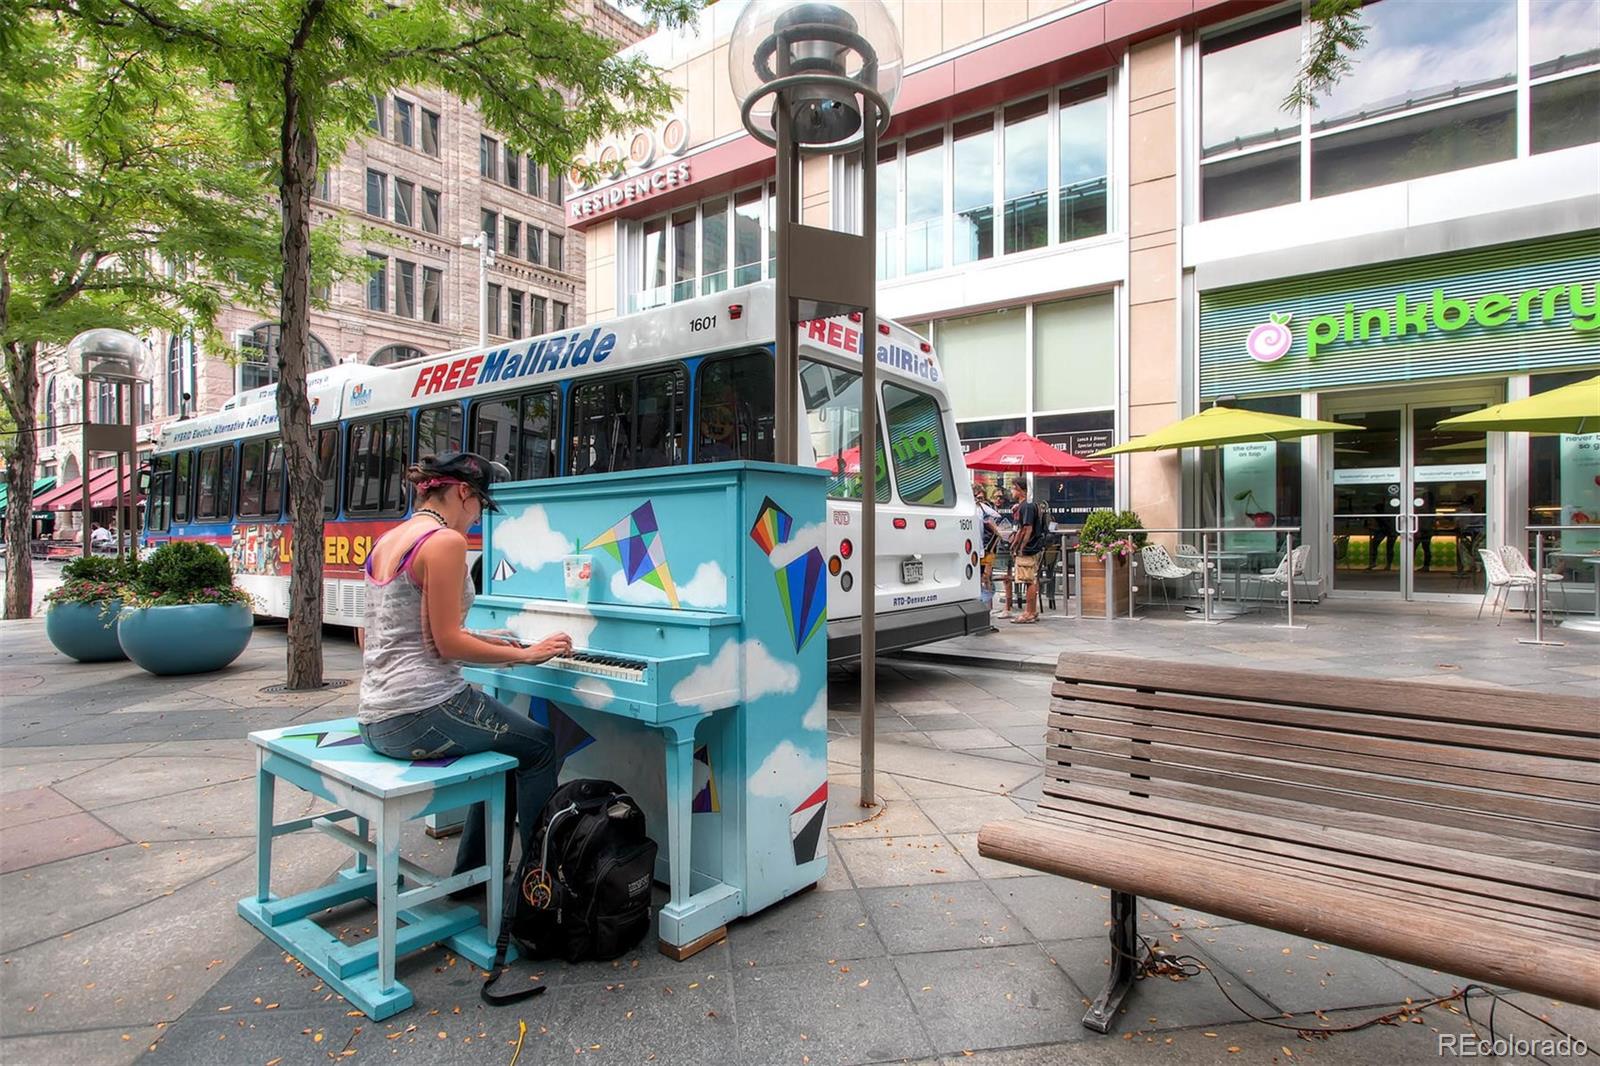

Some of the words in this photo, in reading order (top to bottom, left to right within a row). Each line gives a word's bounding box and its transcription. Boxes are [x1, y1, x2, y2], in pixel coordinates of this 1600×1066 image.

[570, 162, 691, 218] RESIDENCES
[689, 315, 717, 332] 1601
[1306, 284, 1600, 358] pinkberry
[798, 319, 858, 353] REE
[192, 425, 212, 438] Electric
[213, 421, 246, 434] Alternative
[246, 416, 260, 428] Fuel
[959, 519, 973, 531] 1601
